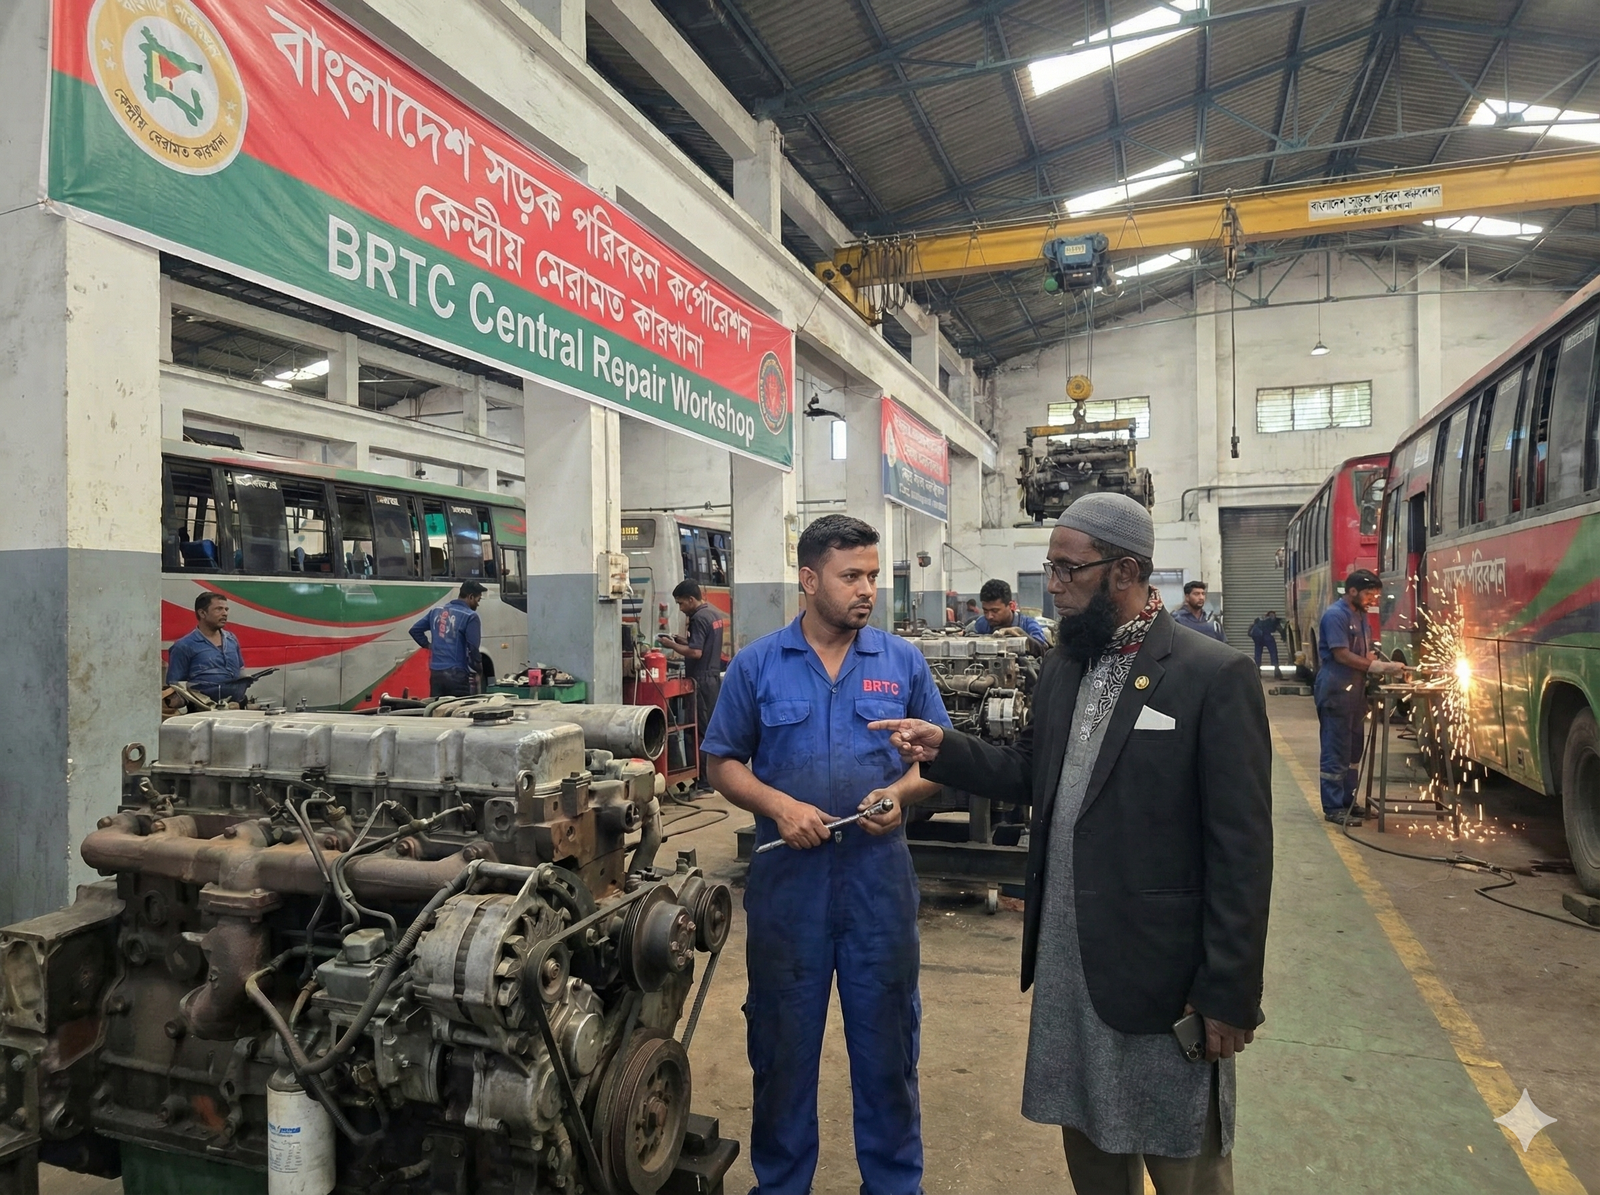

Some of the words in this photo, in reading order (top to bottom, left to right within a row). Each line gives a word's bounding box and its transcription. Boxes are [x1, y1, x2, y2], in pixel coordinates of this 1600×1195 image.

[264, 5, 475, 183] বাংলাদেশ
[481, 144, 562, 231] সড়ক
[572, 205, 660, 295] পরিবহন
[666, 267, 752, 351] কর্পোরেশন
[415, 185, 525, 278] কেন্দ্রীয়
[536, 250, 625, 322] মেরামত
[631, 299, 705, 369] কারখানা
[328, 214, 456, 318] BRTC
[469, 282, 583, 372] Central
[593, 335, 666, 404] Repair
[671, 372, 756, 447] Workshop
[863, 679, 899, 696] BRTC
